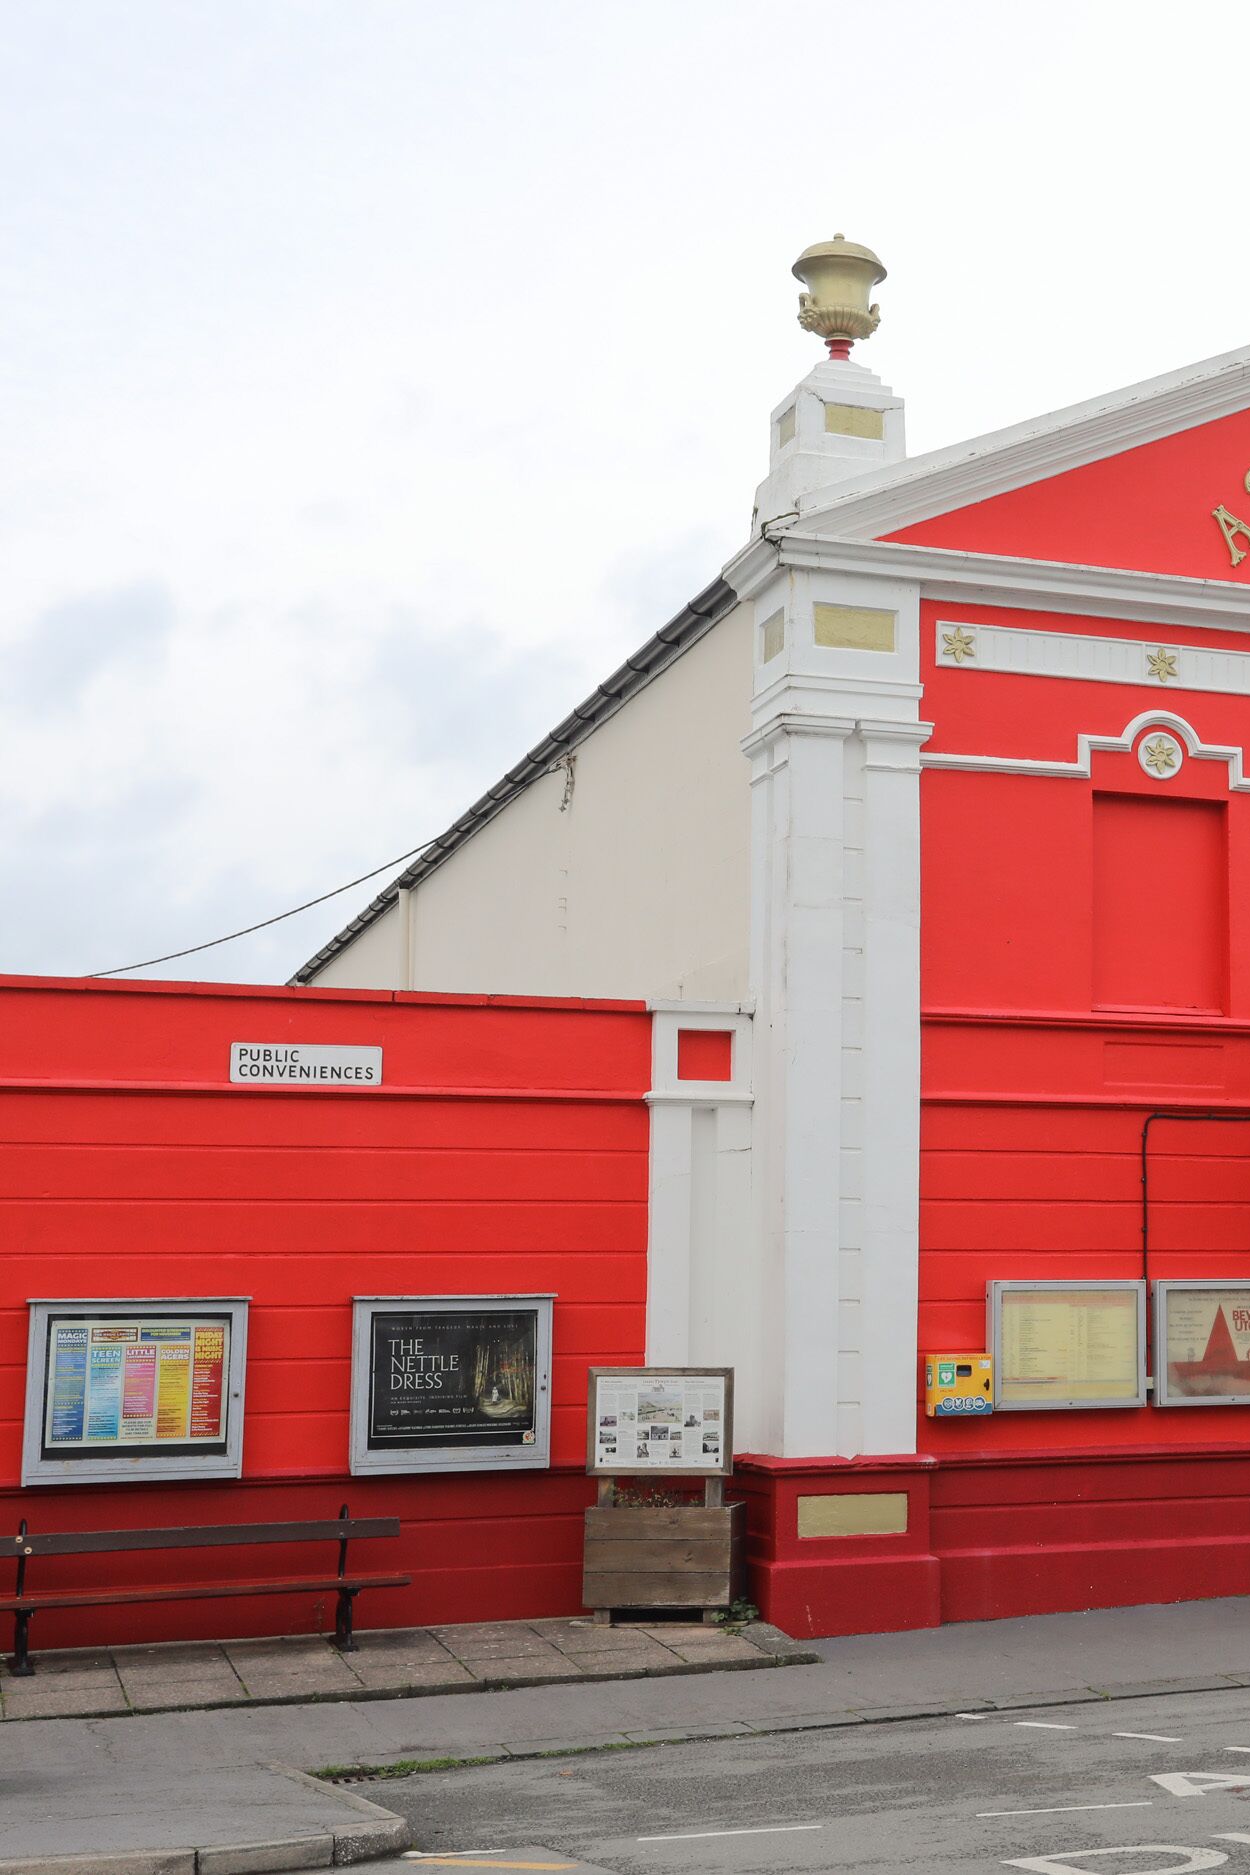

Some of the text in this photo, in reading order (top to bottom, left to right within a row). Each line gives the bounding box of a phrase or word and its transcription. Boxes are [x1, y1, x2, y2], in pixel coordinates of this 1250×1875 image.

[239, 1048, 300, 1062] PUBLIC
[238, 1064, 374, 1080] CONVENIENCES
[57, 1332, 88, 1340] MAGIC
[195, 1338, 223, 1346] NIGHT
[388, 1338, 424, 1355] THE
[91, 1350, 121, 1358] TEEN
[194, 1351, 223, 1359] NIGHT
[391, 1354, 459, 1373] NETTLE
[390, 1372, 443, 1390] DRESS
